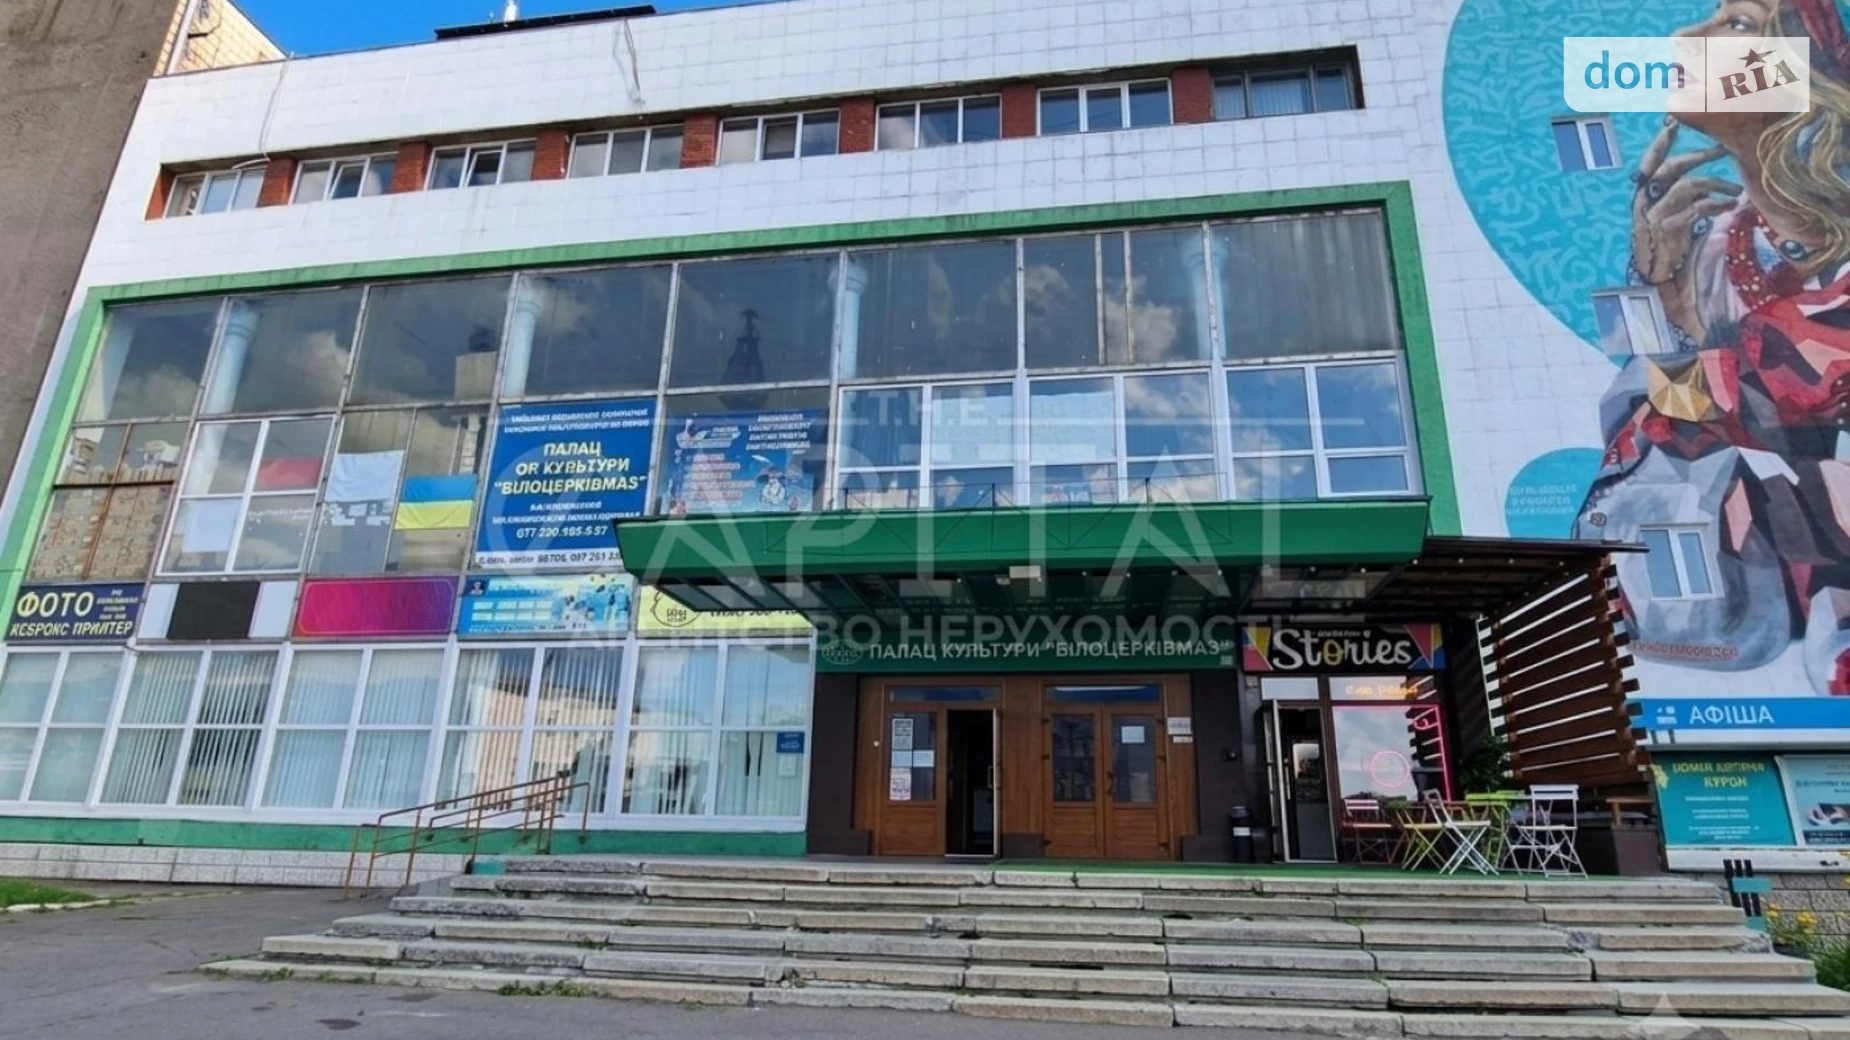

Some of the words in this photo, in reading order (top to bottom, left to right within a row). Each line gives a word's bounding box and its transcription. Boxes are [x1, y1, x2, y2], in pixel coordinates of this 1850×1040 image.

[544, 441, 602, 456] ПАЛАЦ
[17, 591, 94, 617] ФОТО
[870, 644, 936, 661] ПАЛАЦ
[1272, 628, 1411, 670] Stories
[1689, 705, 1775, 724] АФІША
